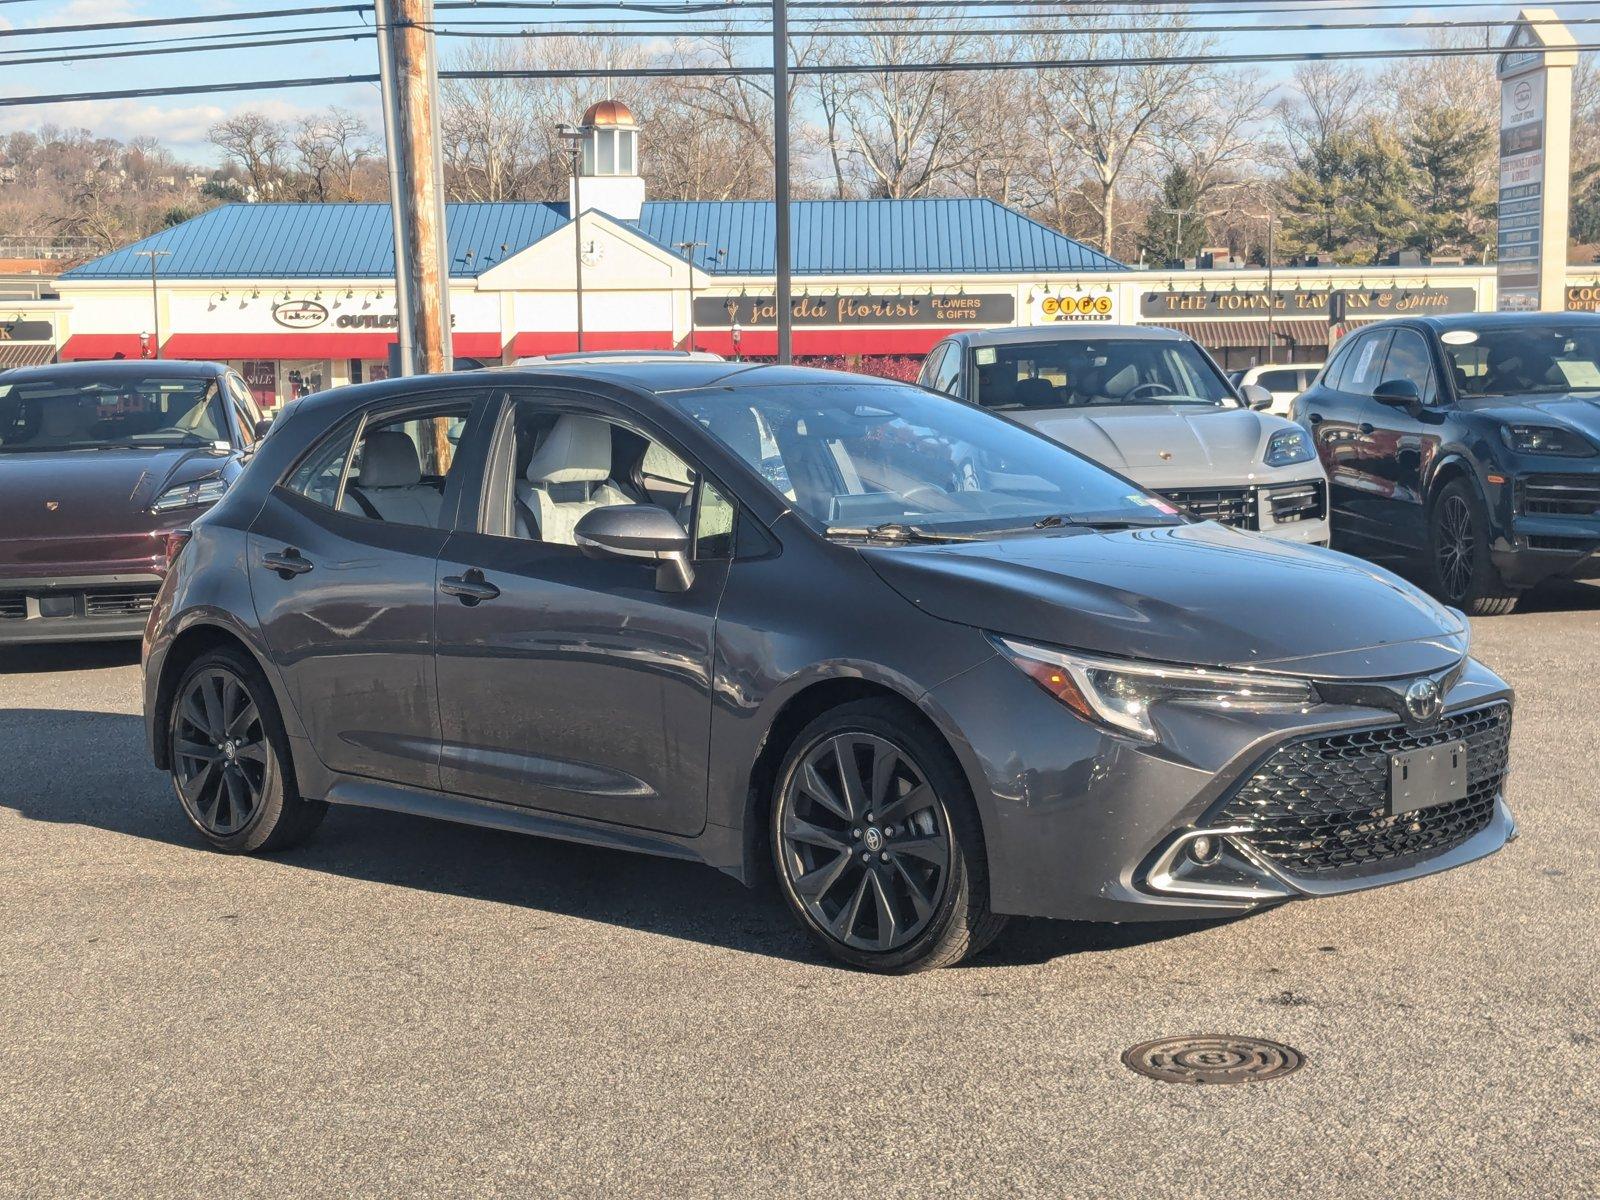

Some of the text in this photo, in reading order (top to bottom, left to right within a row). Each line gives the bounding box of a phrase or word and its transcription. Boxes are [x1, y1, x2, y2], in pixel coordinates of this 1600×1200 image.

[931, 299, 982, 308] FLOWERS
[1045, 298, 1109, 312] ZIPS
[1165, 295, 1207, 310] THE
[1215, 294, 1287, 310] TOWNE
[1377, 293, 1393, 308] &
[1395, 291, 1449, 311] Spirits
[1567, 301, 1600, 311] OPTI
[751, 298, 828, 323] jada
[936, 310, 977, 319] & GIFTS
[246, 374, 274, 385] SALE
